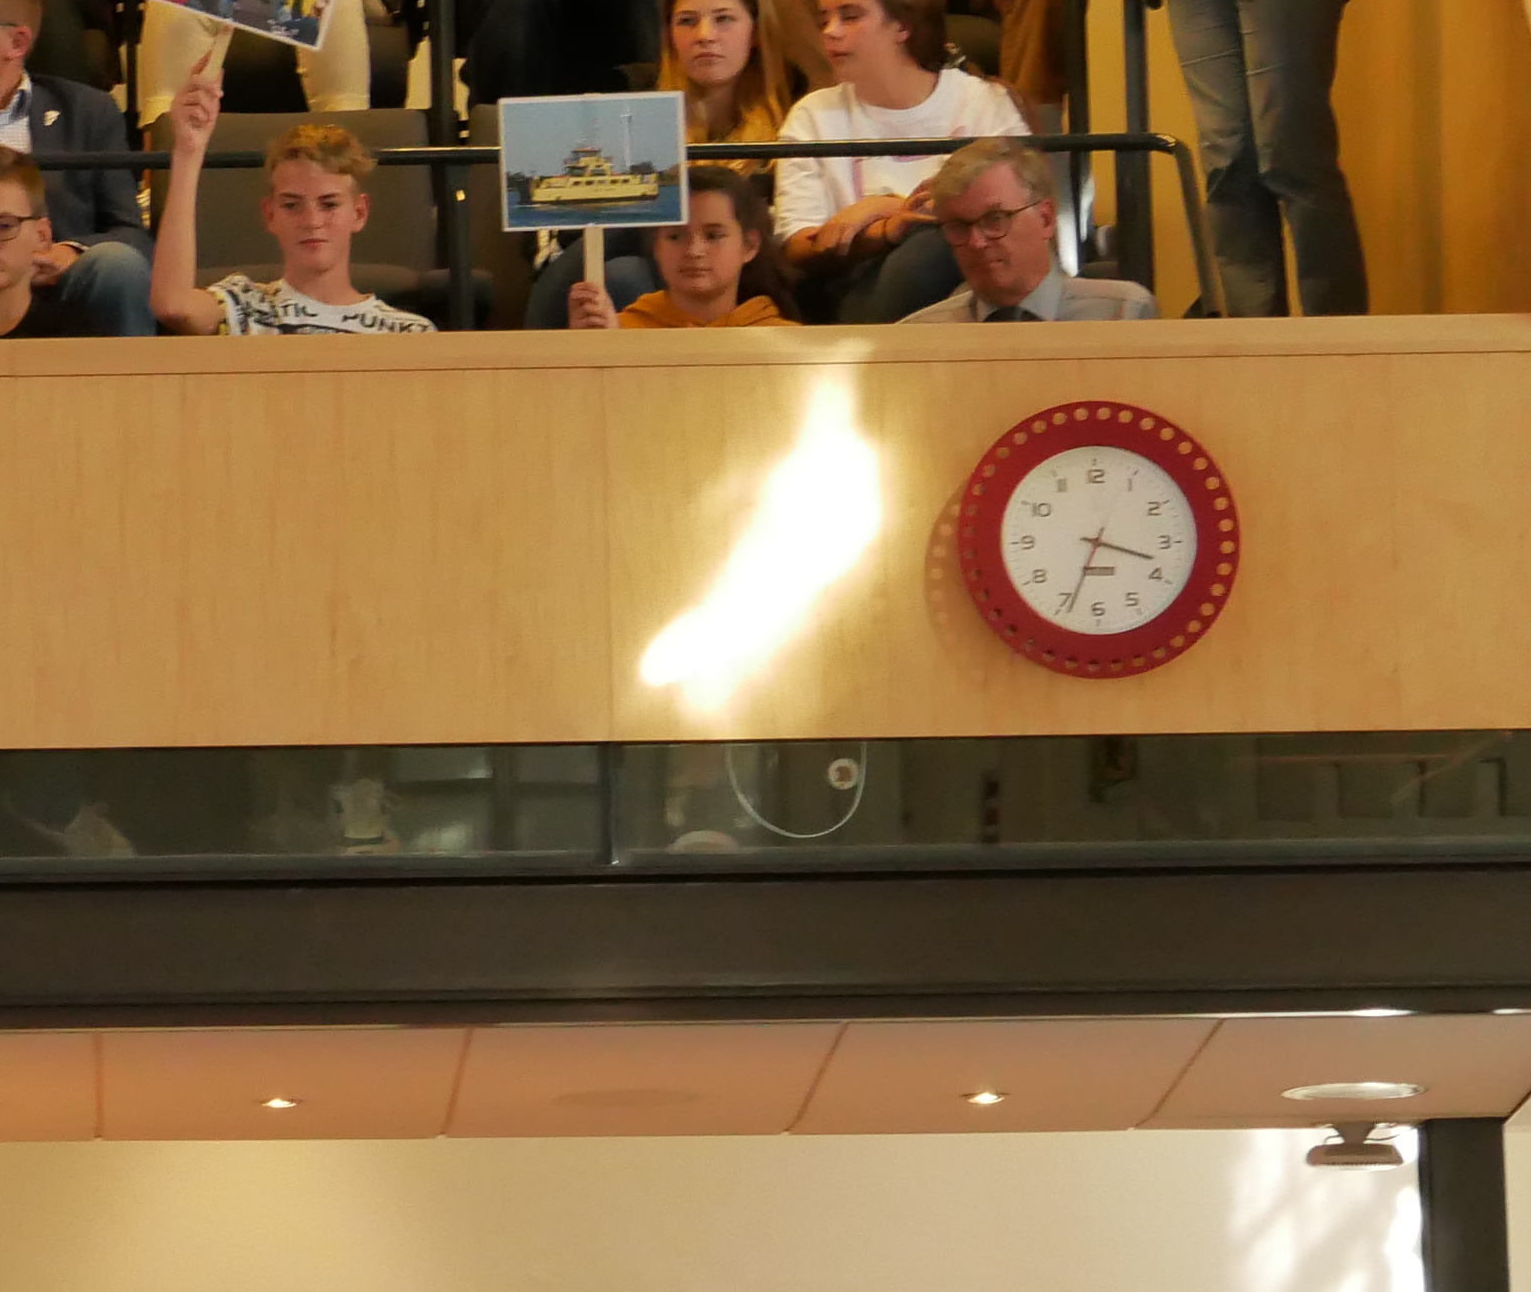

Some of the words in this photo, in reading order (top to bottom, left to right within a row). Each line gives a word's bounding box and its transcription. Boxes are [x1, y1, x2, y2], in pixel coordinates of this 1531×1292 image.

[1146, 501, 1161, 516] 2
[1020, 535, 1035, 550] 9
[1158, 534, 1171, 550] 3
[1032, 569, 1047, 584] 8
[1148, 567, 1164, 581] 4
[1058, 592, 1073, 608] 7
[1124, 591, 1140, 607] 5
[1090, 601, 1106, 617] 6
